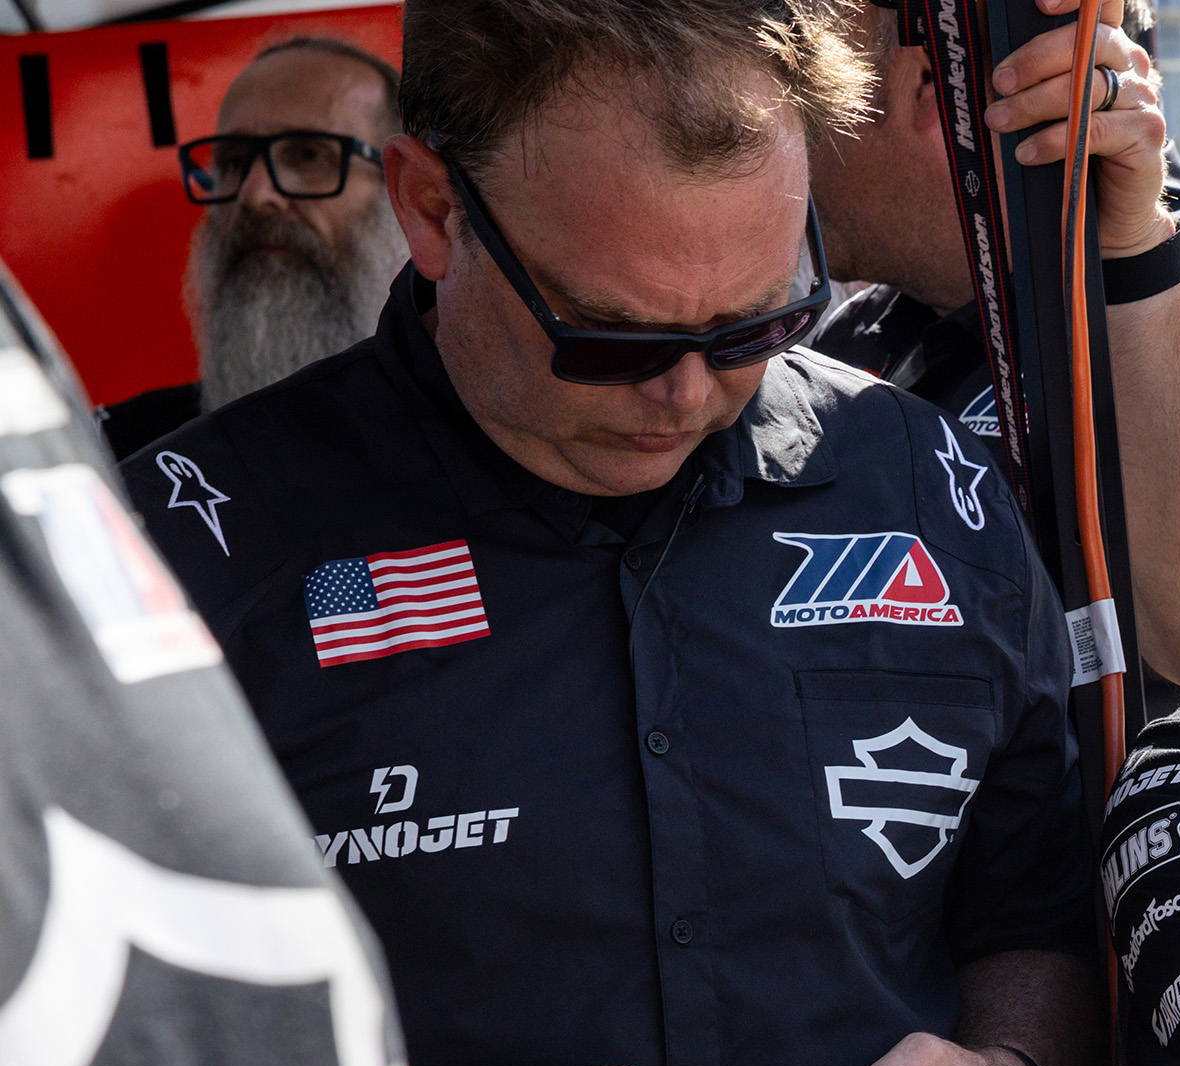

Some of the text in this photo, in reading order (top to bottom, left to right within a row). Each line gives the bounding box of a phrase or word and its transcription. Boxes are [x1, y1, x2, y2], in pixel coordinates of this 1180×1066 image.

[774, 603, 960, 624] MOTOAMERICA
[314, 807, 520, 868] YNOJET
[1103, 817, 1174, 920] HLINS
